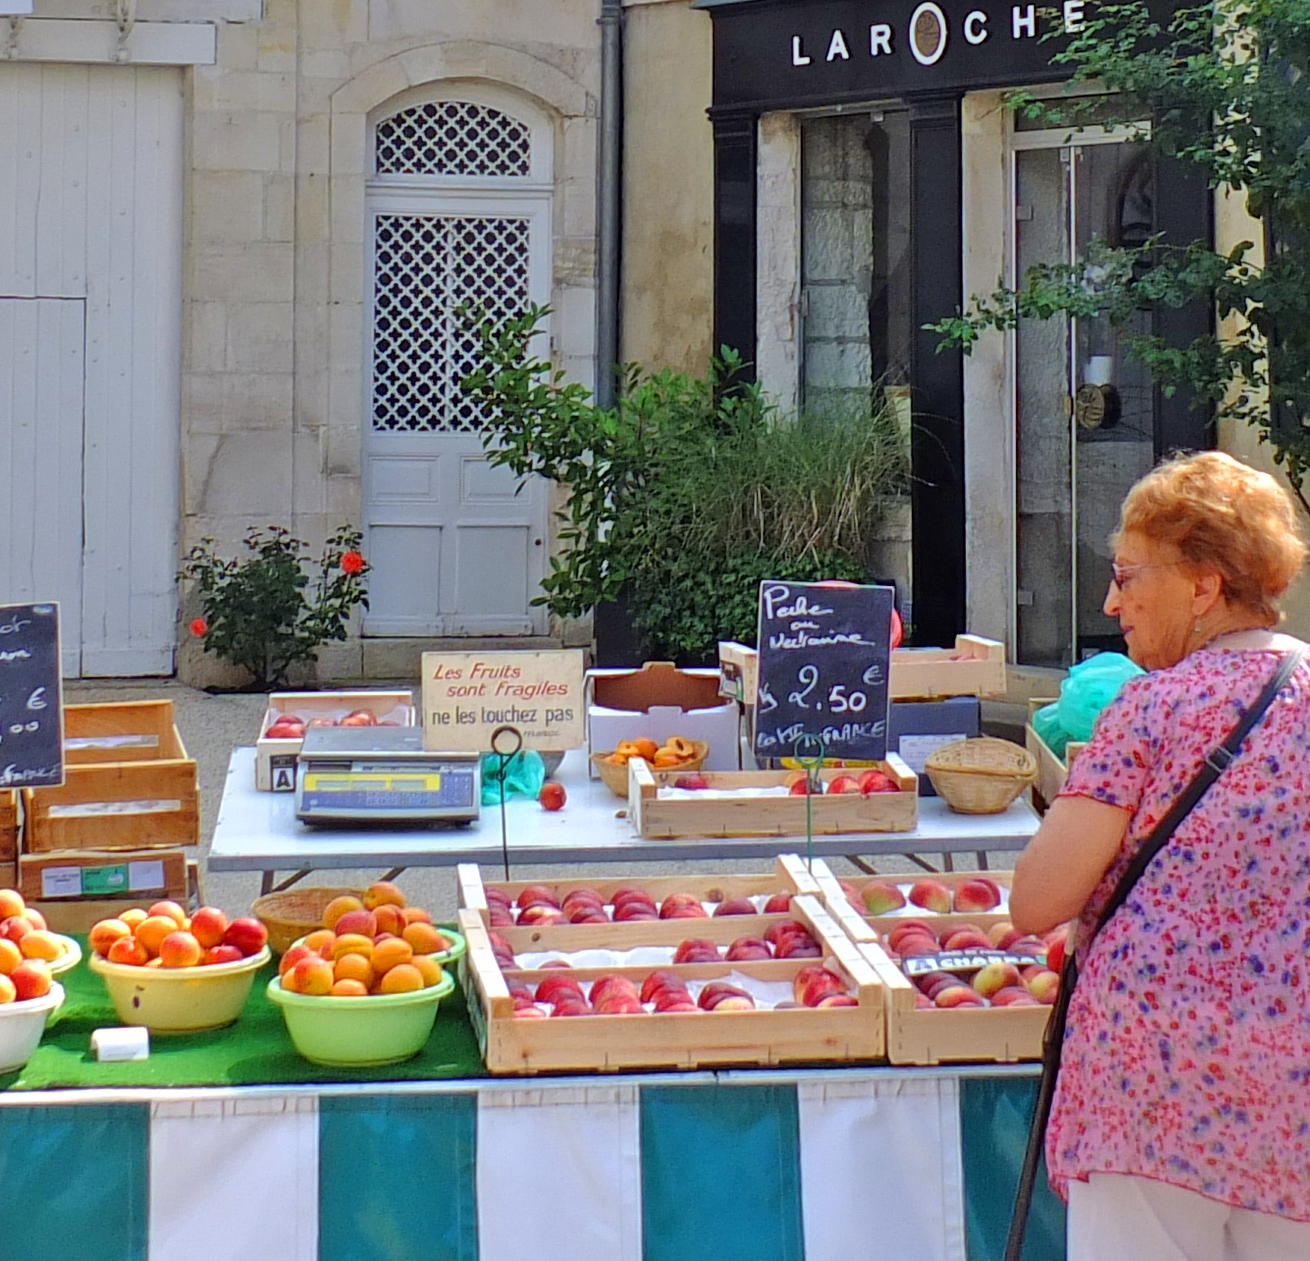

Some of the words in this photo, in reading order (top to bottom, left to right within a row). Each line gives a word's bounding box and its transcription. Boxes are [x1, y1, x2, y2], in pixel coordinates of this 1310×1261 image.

[792, 0, 1086, 66] LAROCHE
[433, 664, 464, 680] Les
[469, 662, 522, 680] Fruits
[863, 665, 885, 686] €
[27, 687, 48, 710] €
[447, 683, 487, 698] sont
[432, 710, 451, 725] ne
[456, 705, 477, 725] les
[481, 704, 538, 724] touchez
[545, 708, 574, 727] pas
[276, 771, 291, 788] A
